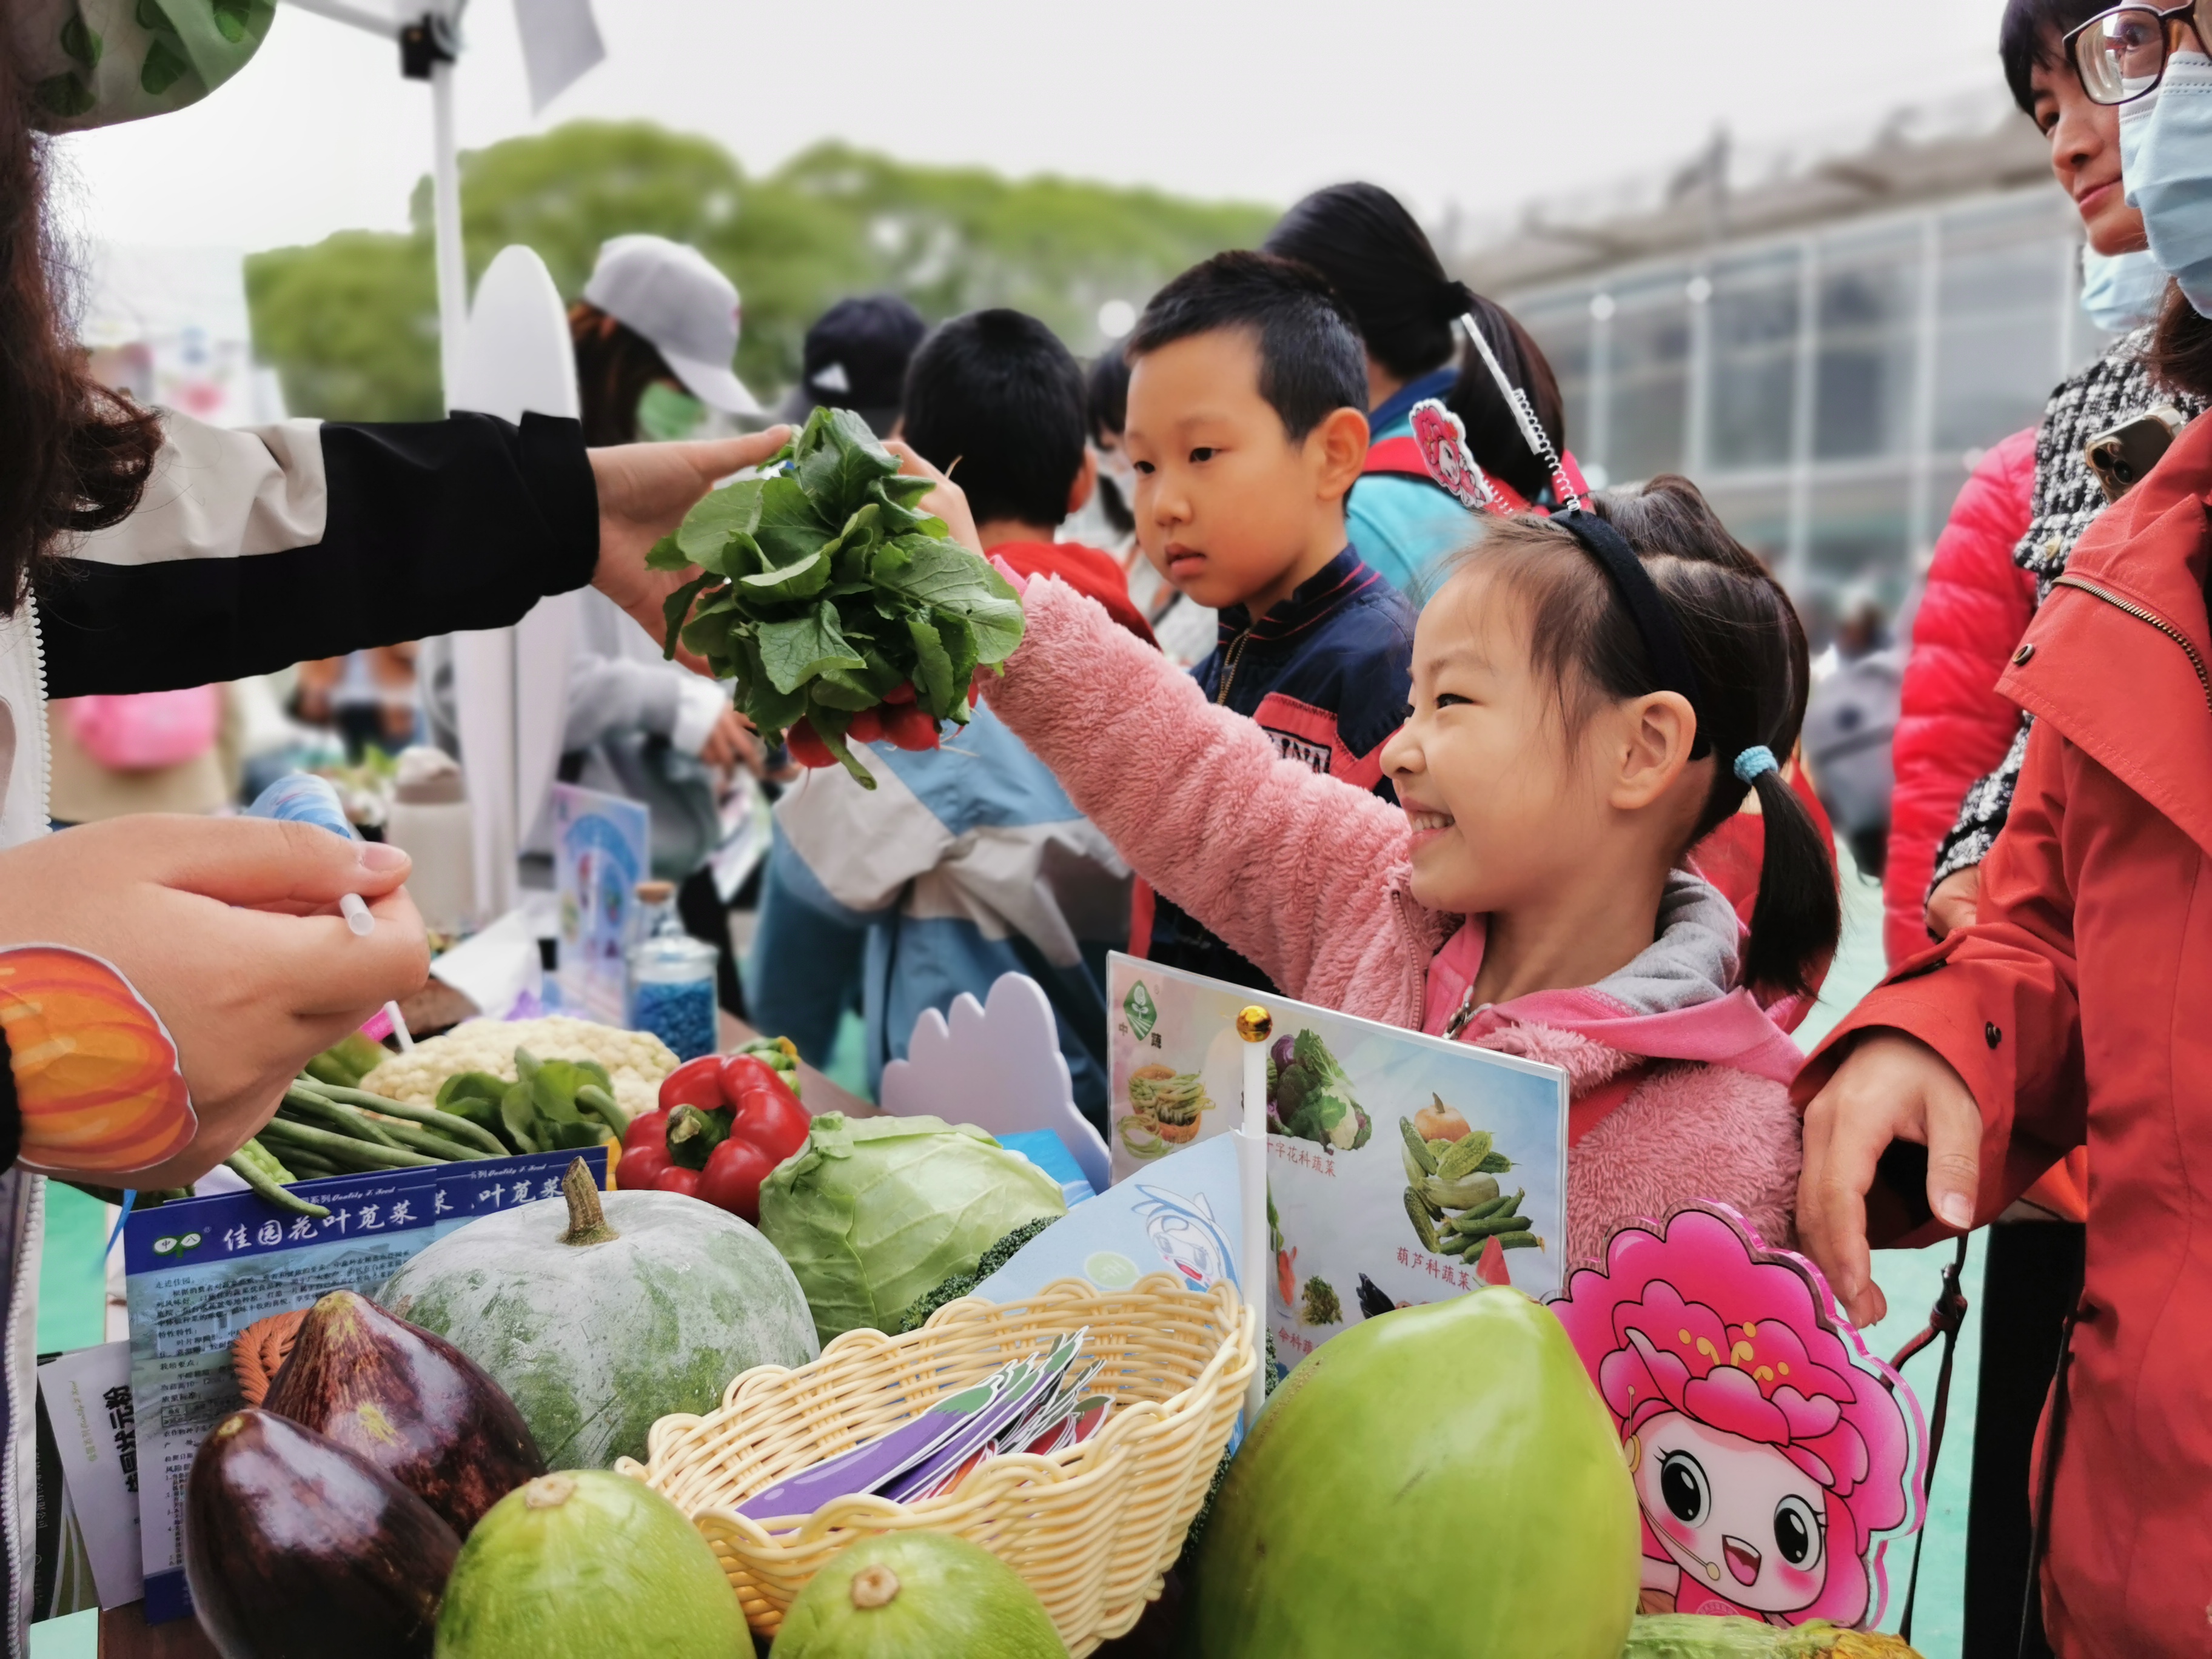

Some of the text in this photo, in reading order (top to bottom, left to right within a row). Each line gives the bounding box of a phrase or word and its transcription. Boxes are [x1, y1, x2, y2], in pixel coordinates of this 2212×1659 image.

[1267, 1139, 1336, 1177] 十字花科蔬菜
[471, 1176, 565, 1209] 叶苋菜
[223, 1199, 418, 1252] 佳园花叶苋菜
[1396, 1246, 1472, 1291] 葫芦科蔬菜
[1278, 1326, 1320, 1356] 伞科蔬
